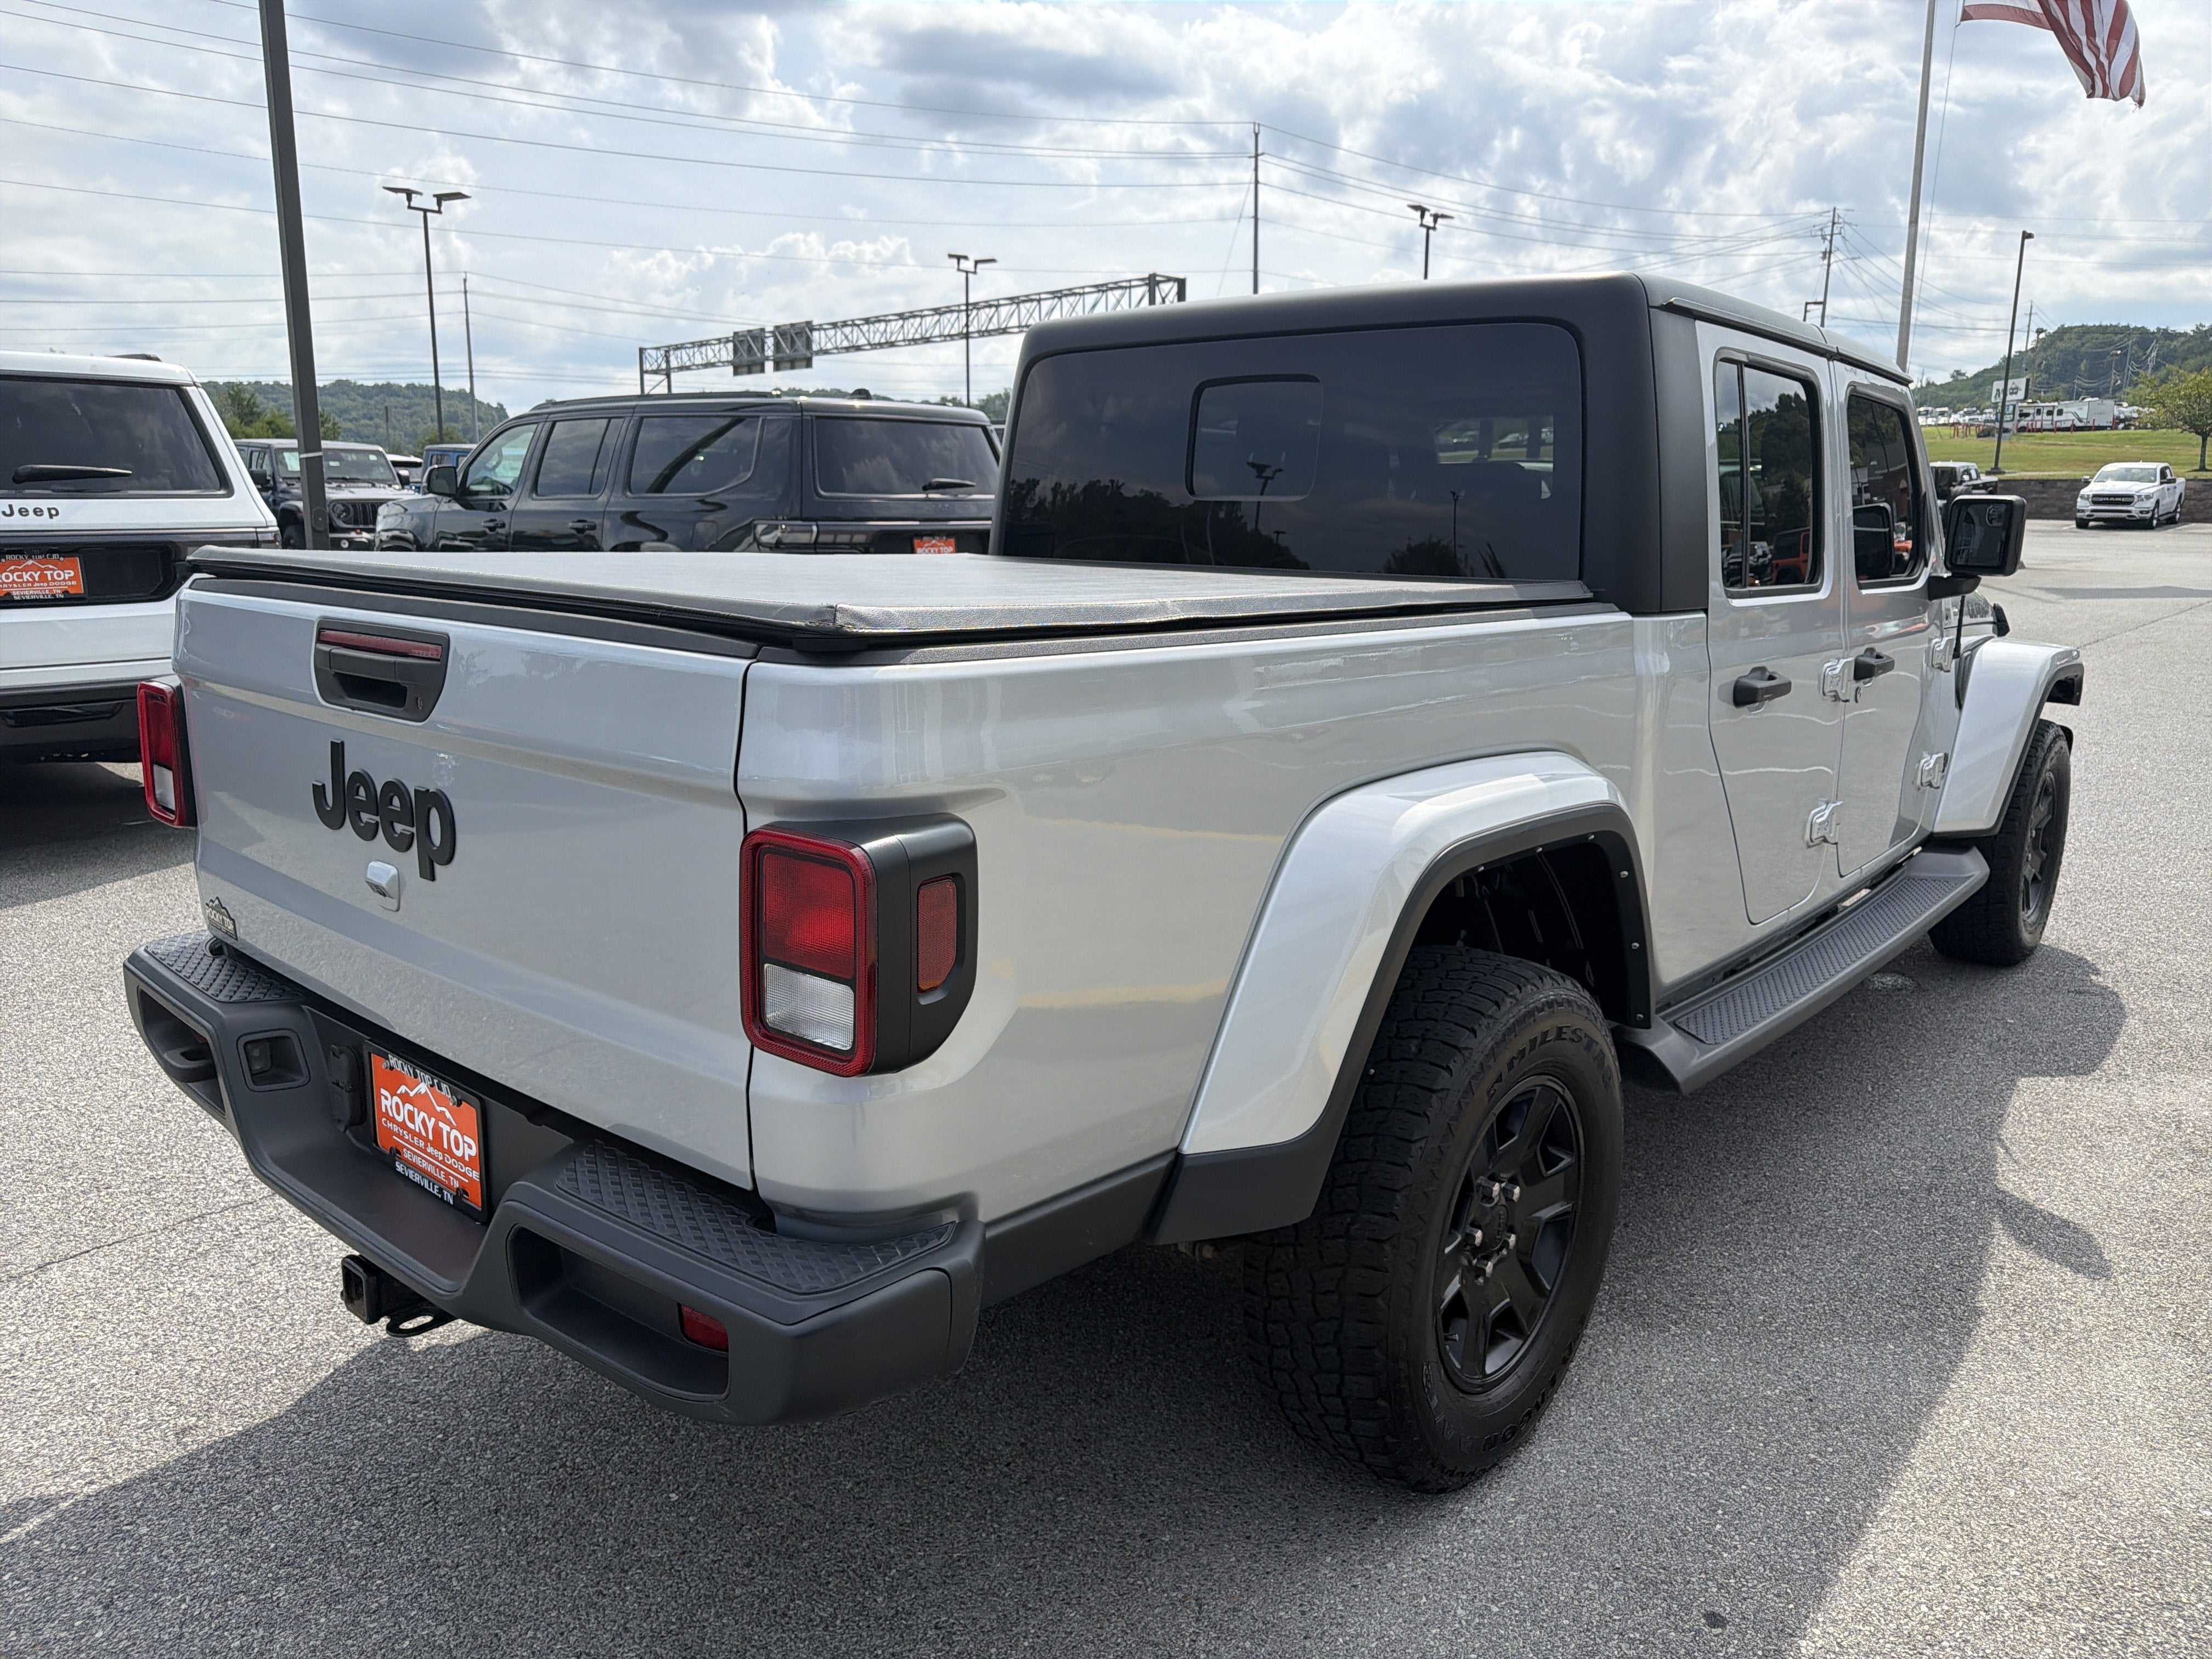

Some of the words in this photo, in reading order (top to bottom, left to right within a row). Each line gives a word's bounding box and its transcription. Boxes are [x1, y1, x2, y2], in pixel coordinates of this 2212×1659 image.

[2, 504, 60, 519] Jeep
[44, 570, 75, 580] TOP
[312, 738, 456, 882] Jeep
[388, 1054, 414, 1079] ROCKY
[415, 1069, 432, 1087] TOP
[433, 1079, 451, 1098] CJD
[380, 1088, 436, 1141] ROCKY
[438, 1121, 477, 1162] TOP
[381, 1118, 425, 1149] CHRYSLER
[426, 1143, 443, 1161] Jeep
[444, 1153, 480, 1182] DODGE
[403, 1148, 448, 1184] SEVIERVILLE,
[449, 1175, 459, 1188] TN
[395, 1161, 442, 1199] SEVIERVILLE,
[443, 1190, 454, 1205] TN
